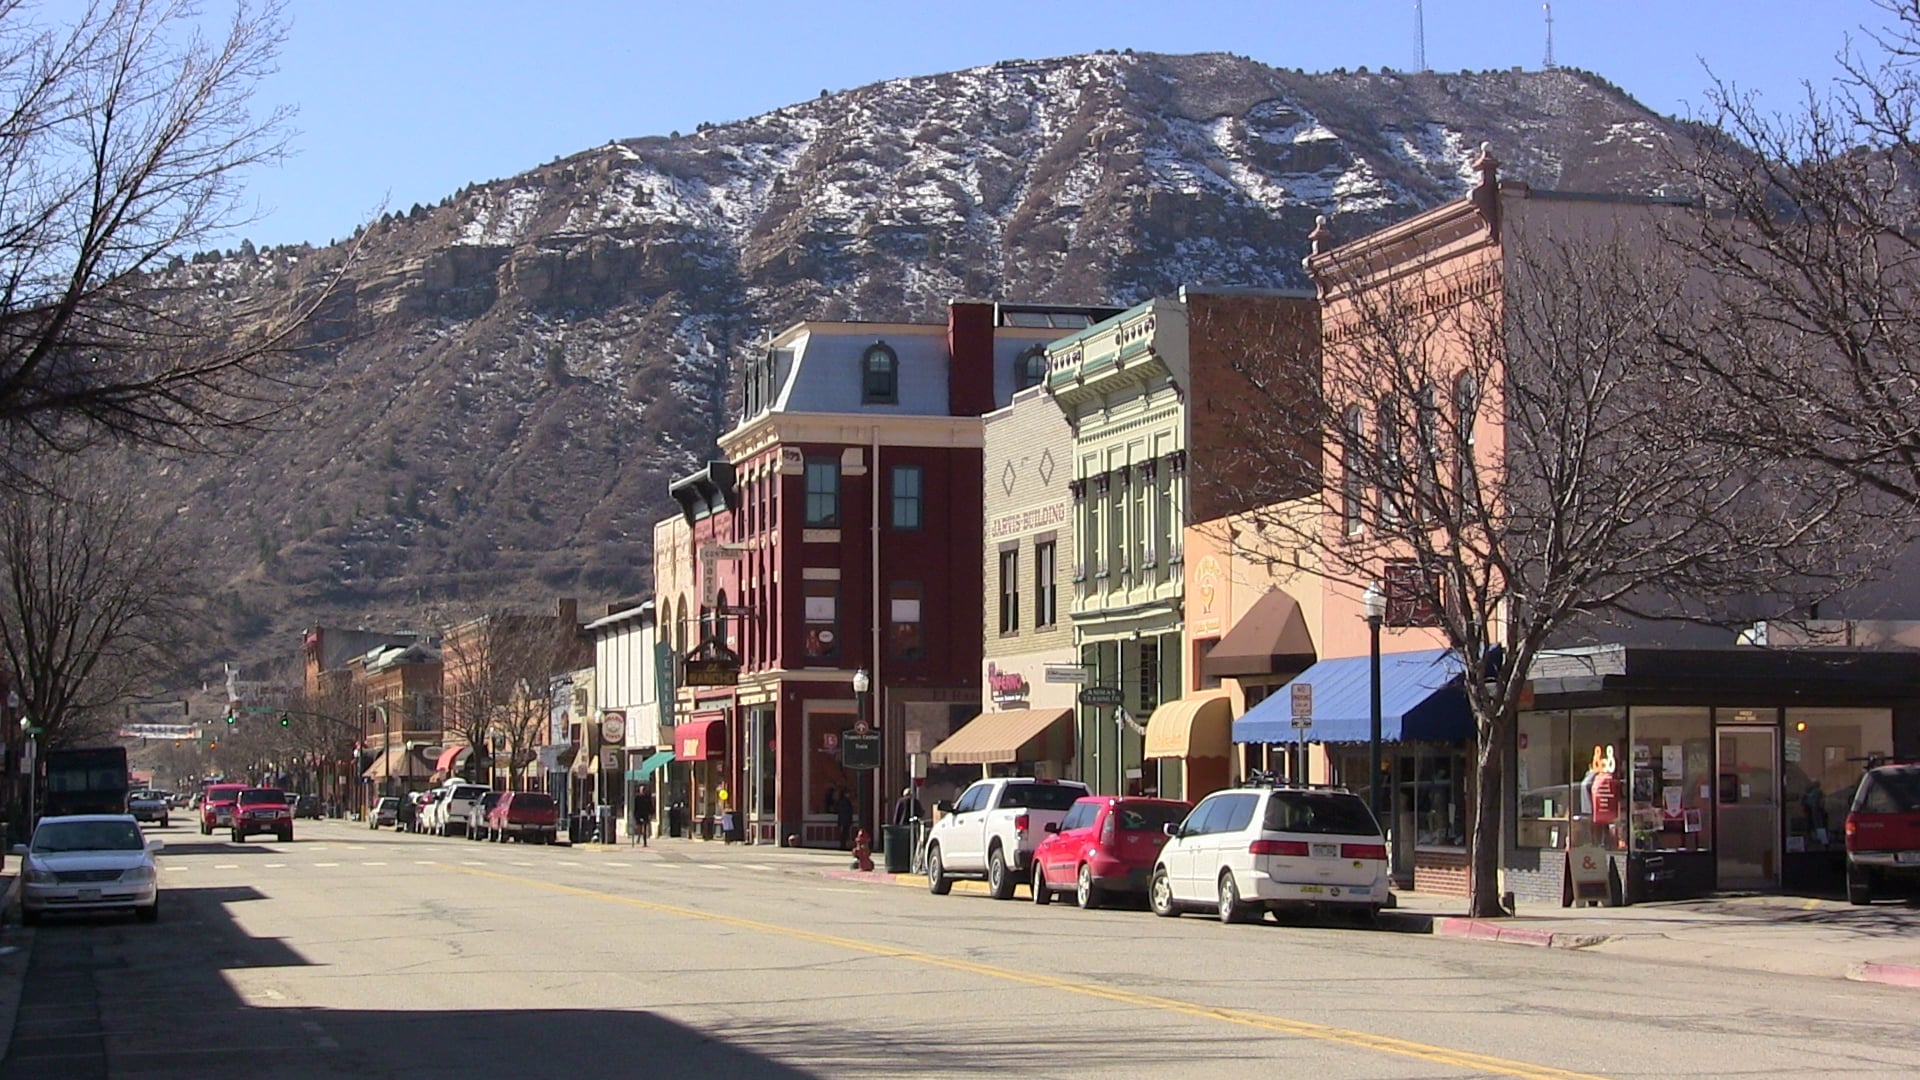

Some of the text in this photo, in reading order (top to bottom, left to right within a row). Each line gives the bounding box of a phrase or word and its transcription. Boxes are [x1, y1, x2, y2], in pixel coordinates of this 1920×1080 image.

[1023, 502, 1065, 530] BUILDING
[705, 559, 714, 603] HOTEL
[664, 648, 674, 724] JEWELRY
[688, 672, 735, 682] RANCHO
